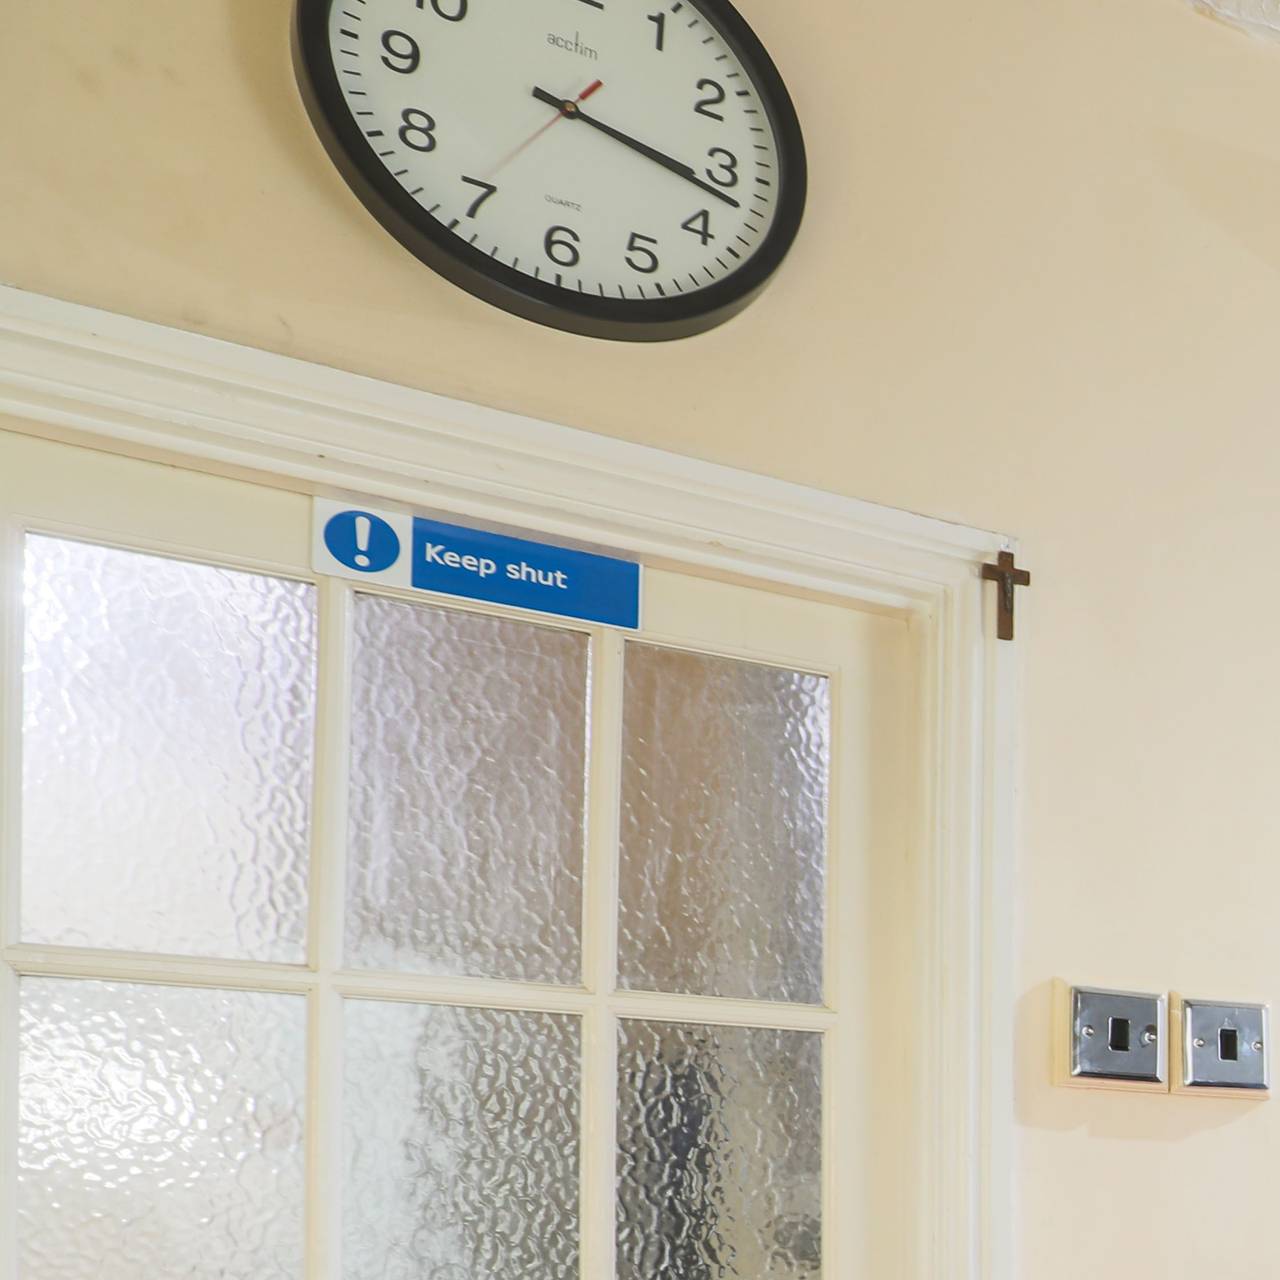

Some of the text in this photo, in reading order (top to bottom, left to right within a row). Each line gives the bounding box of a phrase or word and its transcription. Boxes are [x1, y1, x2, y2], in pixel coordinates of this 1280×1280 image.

[416, 0, 468, 22] 0
[647, 12, 665, 51] 1
[380, 30, 420, 74] 9
[546, 30, 598, 61] acctim
[694, 78, 726, 121] 2
[398, 108, 436, 152] 8
[705, 147, 738, 188] 3
[461, 175, 497, 218] 7
[543, 225, 580, 267] 6
[681, 209, 715, 246] 4
[624, 232, 659, 274] 5
[425, 542, 567, 589] Keep shut
